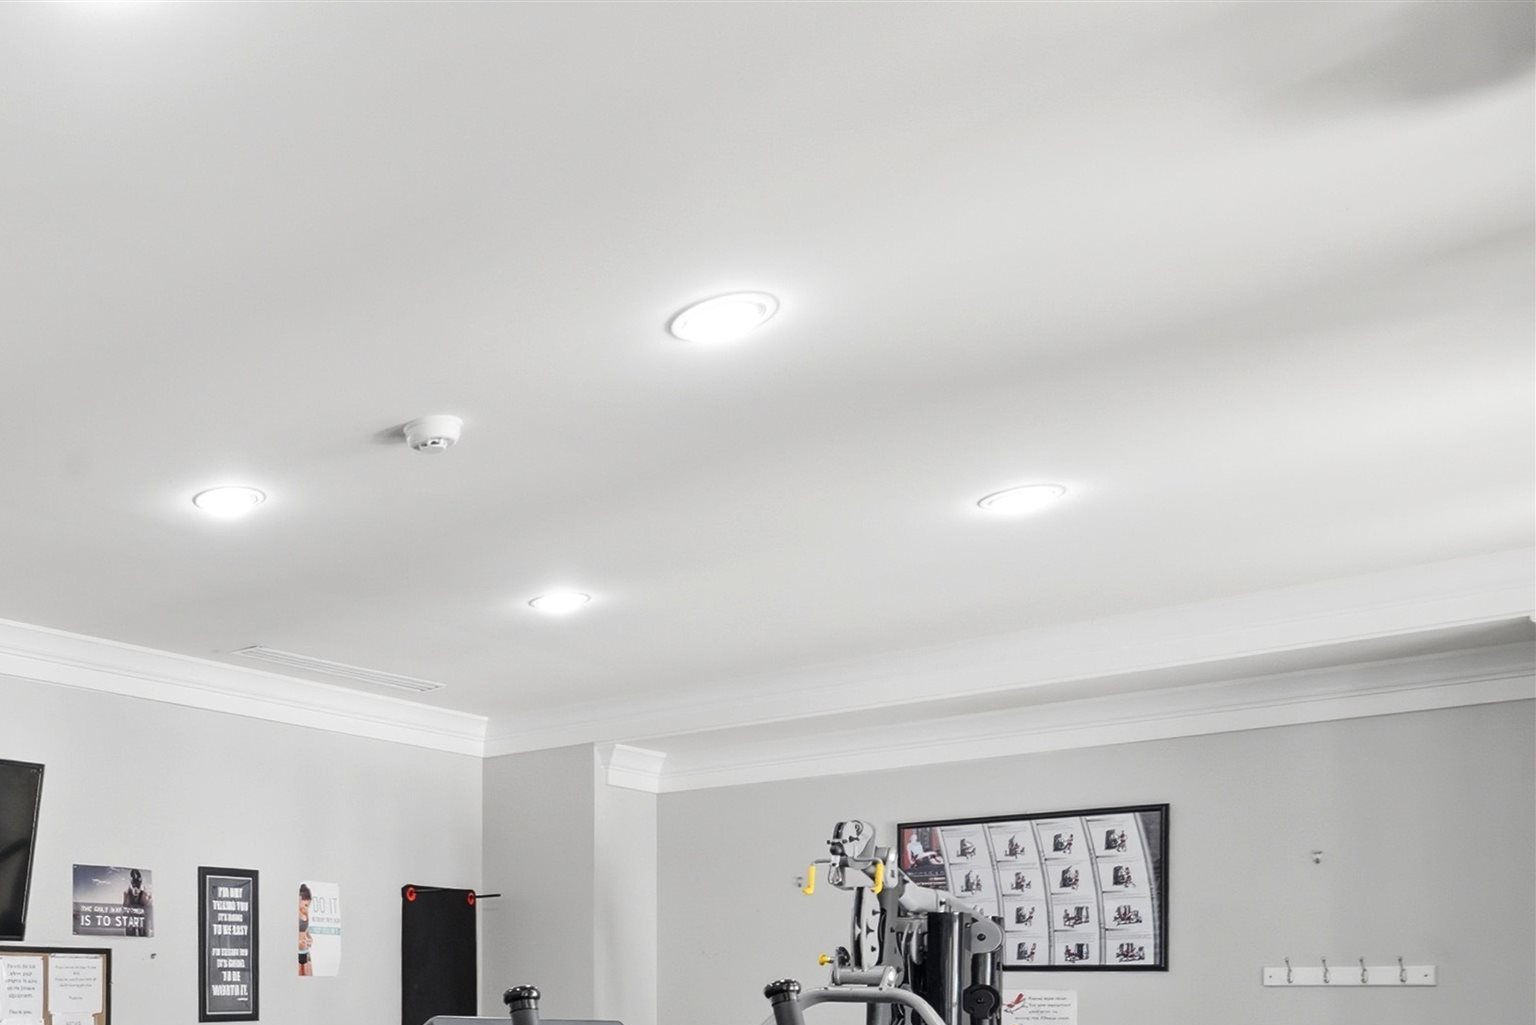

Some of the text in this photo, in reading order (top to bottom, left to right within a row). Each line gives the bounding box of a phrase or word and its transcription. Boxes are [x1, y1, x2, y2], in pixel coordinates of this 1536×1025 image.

[80, 915, 145, 928] IS TO START
